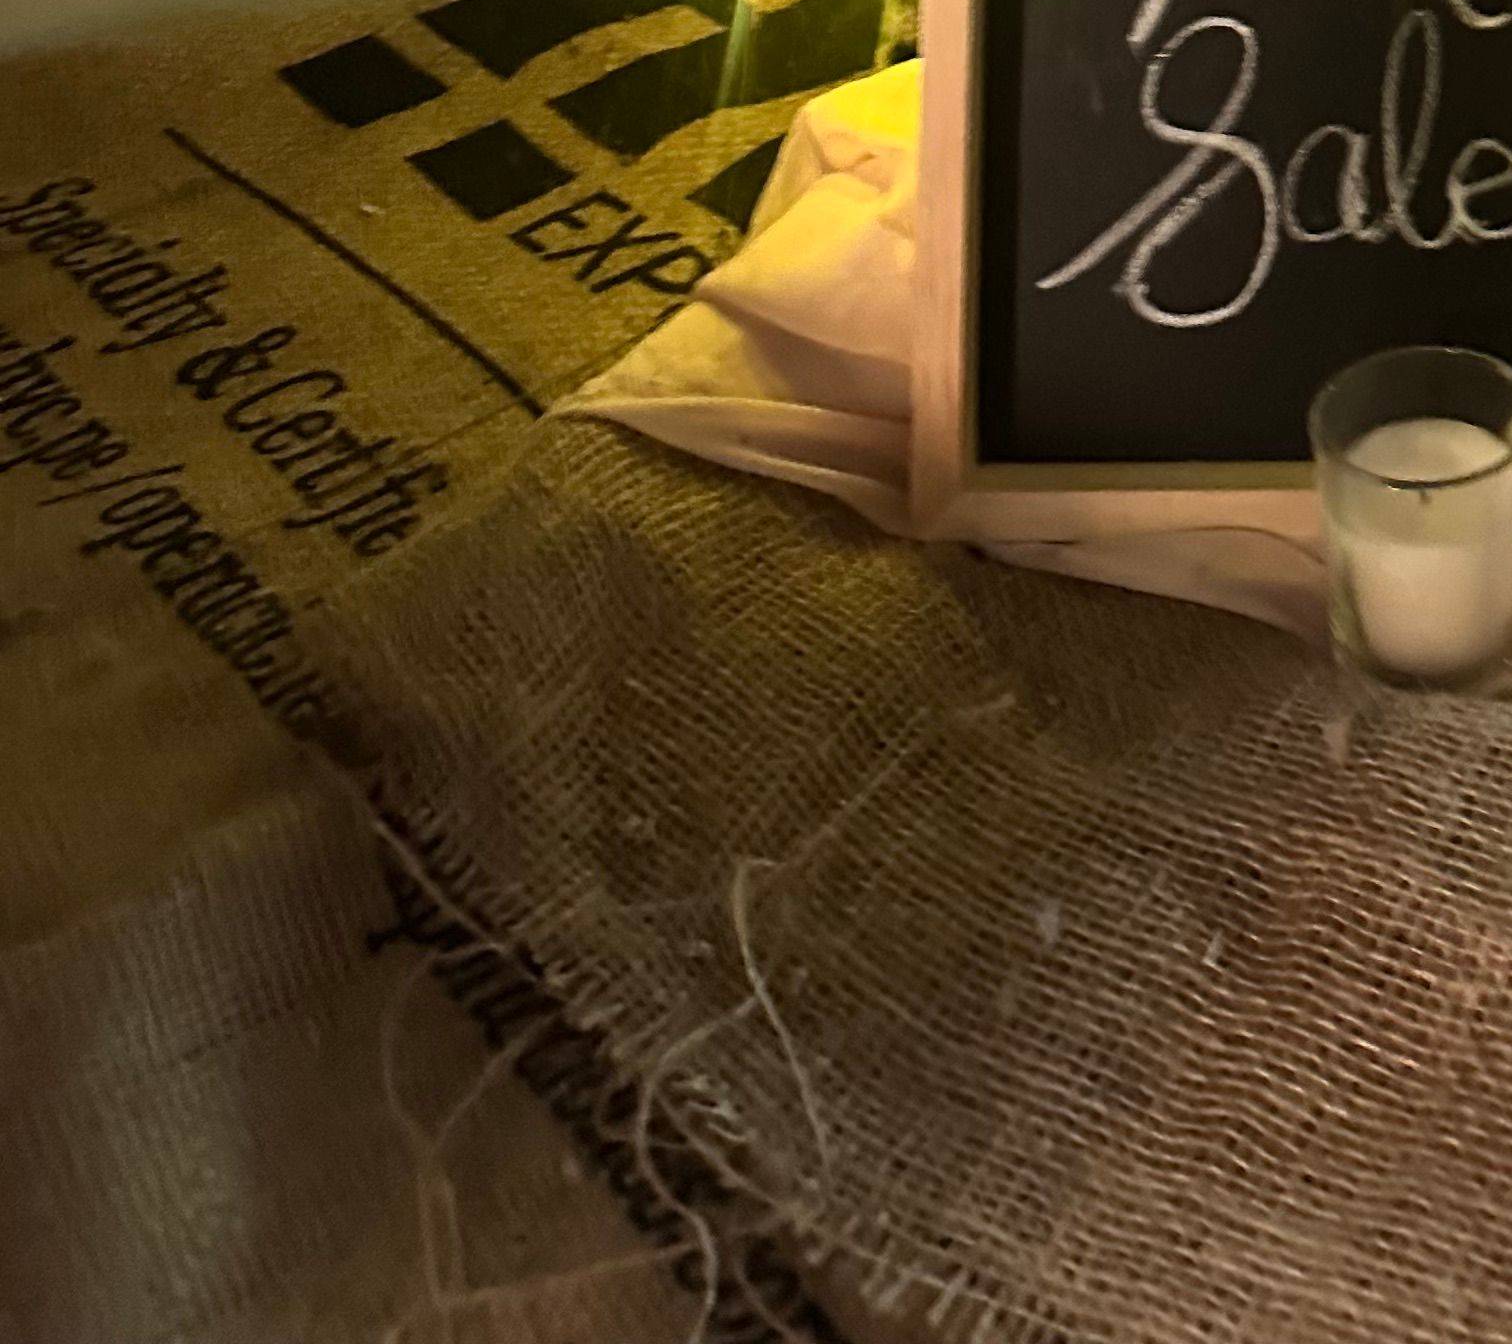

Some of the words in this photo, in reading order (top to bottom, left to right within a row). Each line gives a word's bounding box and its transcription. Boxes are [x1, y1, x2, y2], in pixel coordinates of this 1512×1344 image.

[0, 177, 229, 354] Specialty
[175, 325, 297, 400] &
[506, 185, 714, 296] EXP
